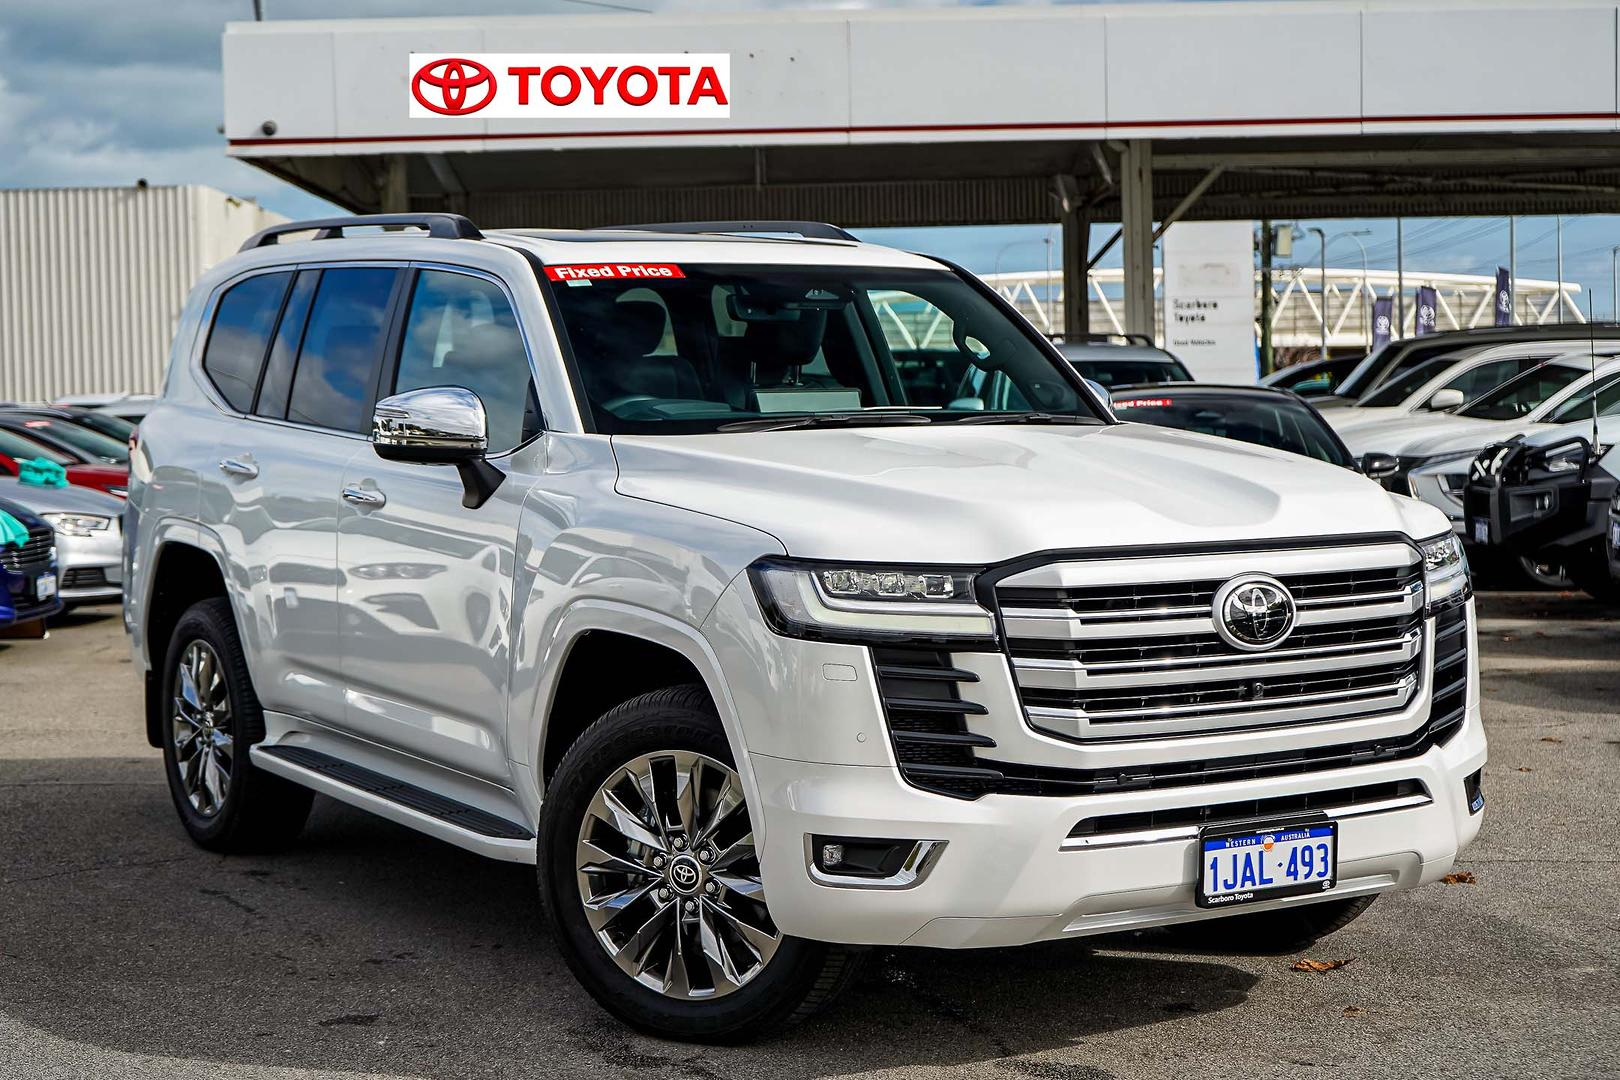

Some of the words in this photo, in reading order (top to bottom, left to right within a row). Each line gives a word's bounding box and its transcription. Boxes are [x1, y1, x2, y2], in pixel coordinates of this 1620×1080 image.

[554, 265, 615, 279] Fixed
[616, 265, 673, 278] Price
[1174, 313, 1206, 325] Toyota
[1225, 838, 1256, 848] WESTERN
[1280, 831, 1311, 841] AUSTRALIA
[1207, 895, 1234, 904] Scarboro
[1234, 892, 1254, 901] Toyota
